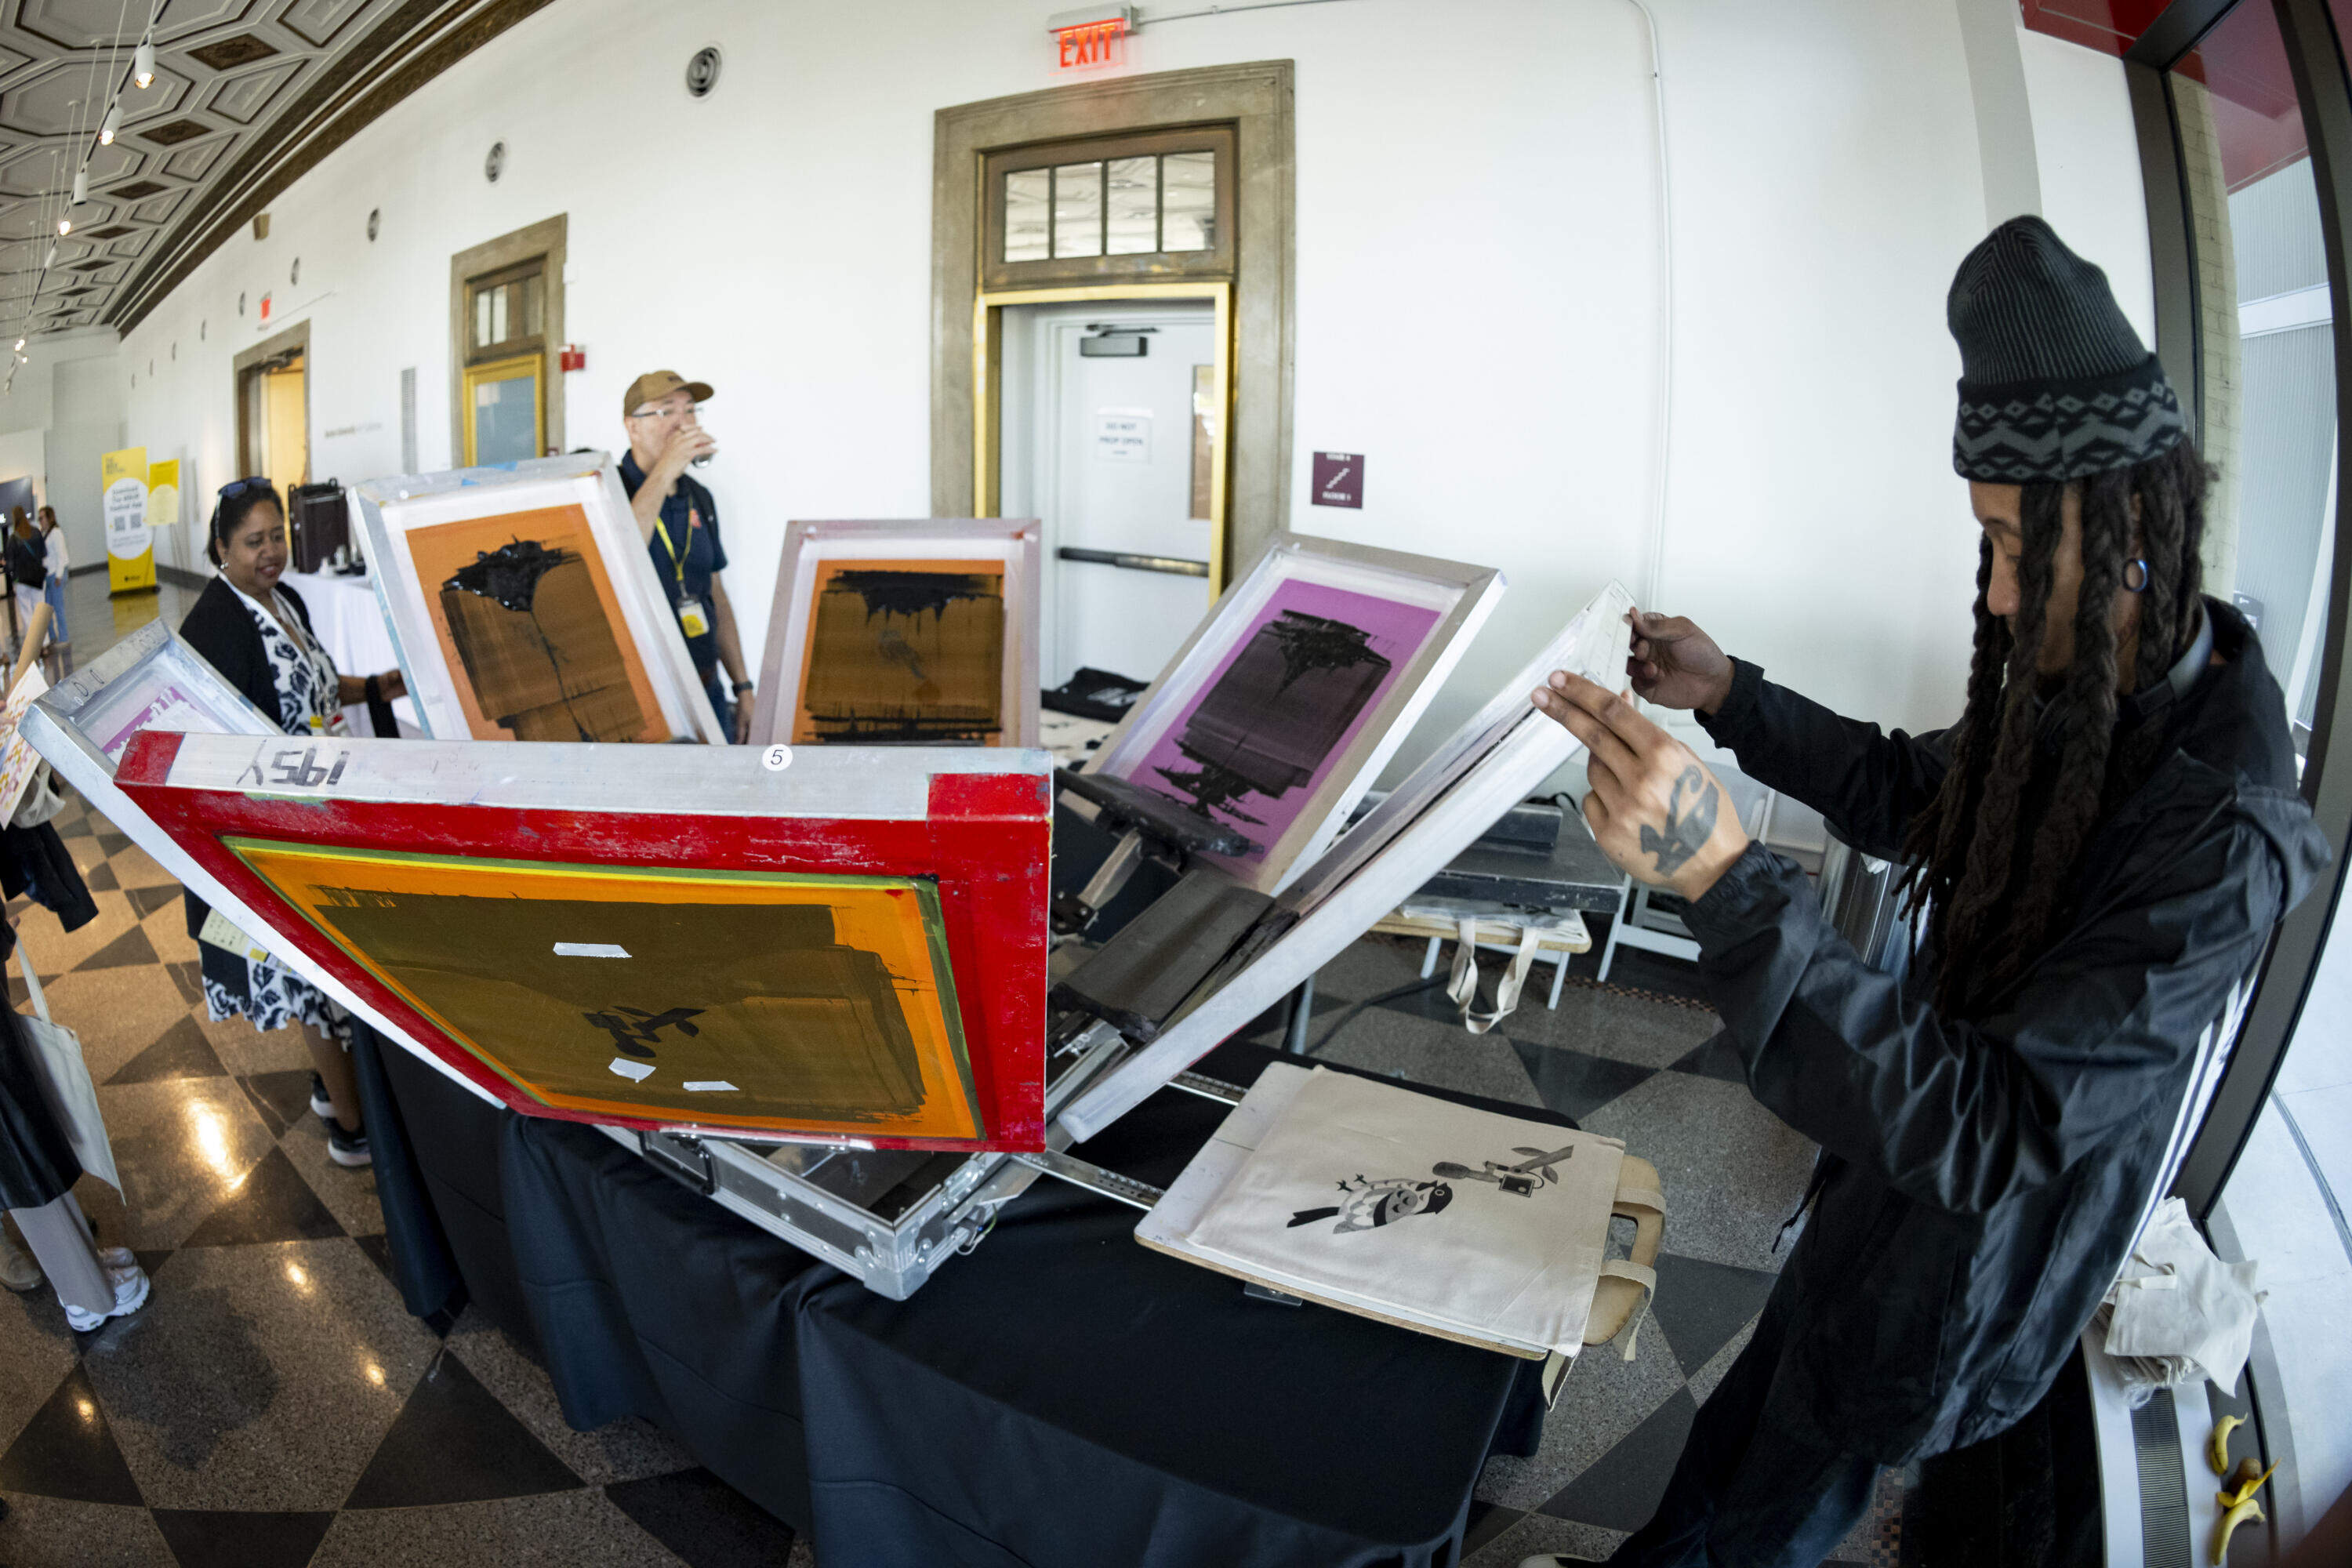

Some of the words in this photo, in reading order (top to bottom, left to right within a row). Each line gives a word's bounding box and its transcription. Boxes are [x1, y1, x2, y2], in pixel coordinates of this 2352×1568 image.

[1060, 23, 1116, 67] EXIT
[235, 739, 350, 786] 195Y
[771, 749, 784, 765] 5
